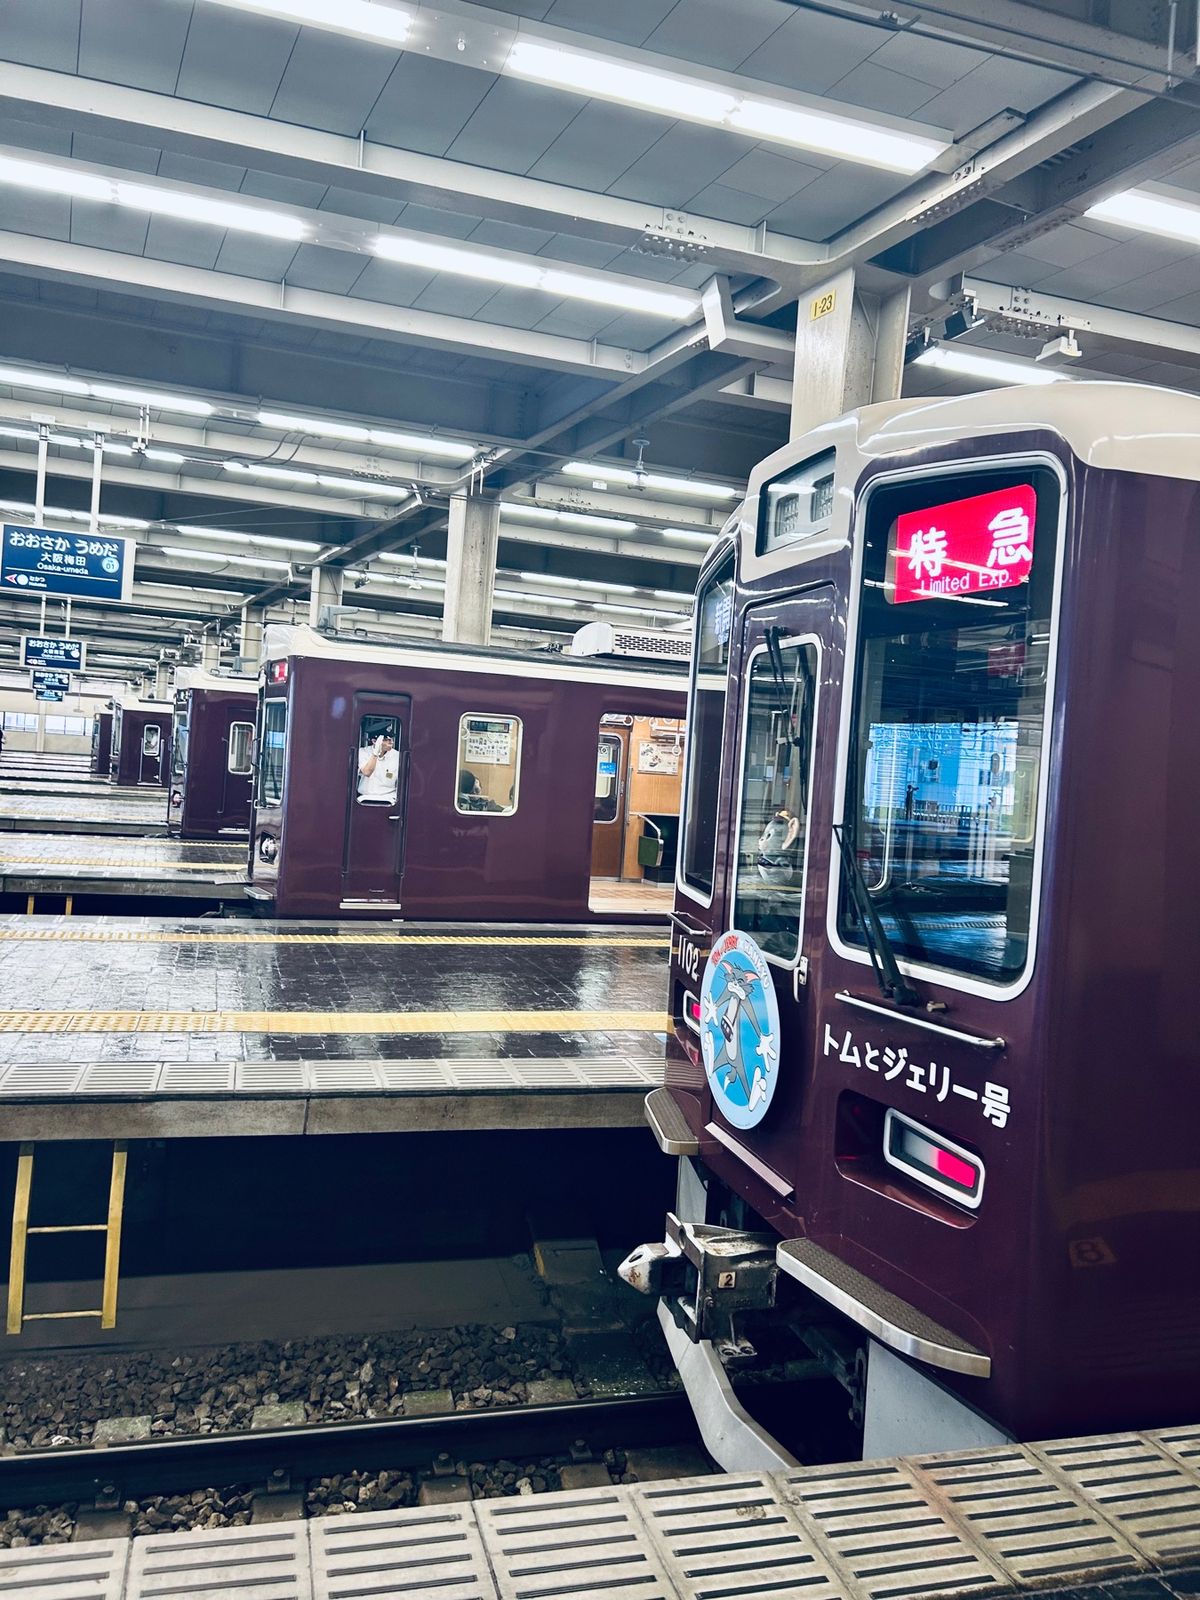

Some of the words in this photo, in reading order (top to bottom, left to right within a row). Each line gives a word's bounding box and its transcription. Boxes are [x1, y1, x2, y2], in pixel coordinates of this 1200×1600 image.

[9, 531, 71, 553] おおさか
[75, 538, 119, 559] うめだ
[908, 506, 1033, 580] 特急
[40, 552, 87, 567] 大阪梅田
[920, 572, 971, 593] Limited
[978, 569, 1013, 589] Exp.
[677, 934, 701, 983] 1102
[823, 1023, 1011, 1129] トムとジェリー号
[724, 1273, 733, 1287] 2
